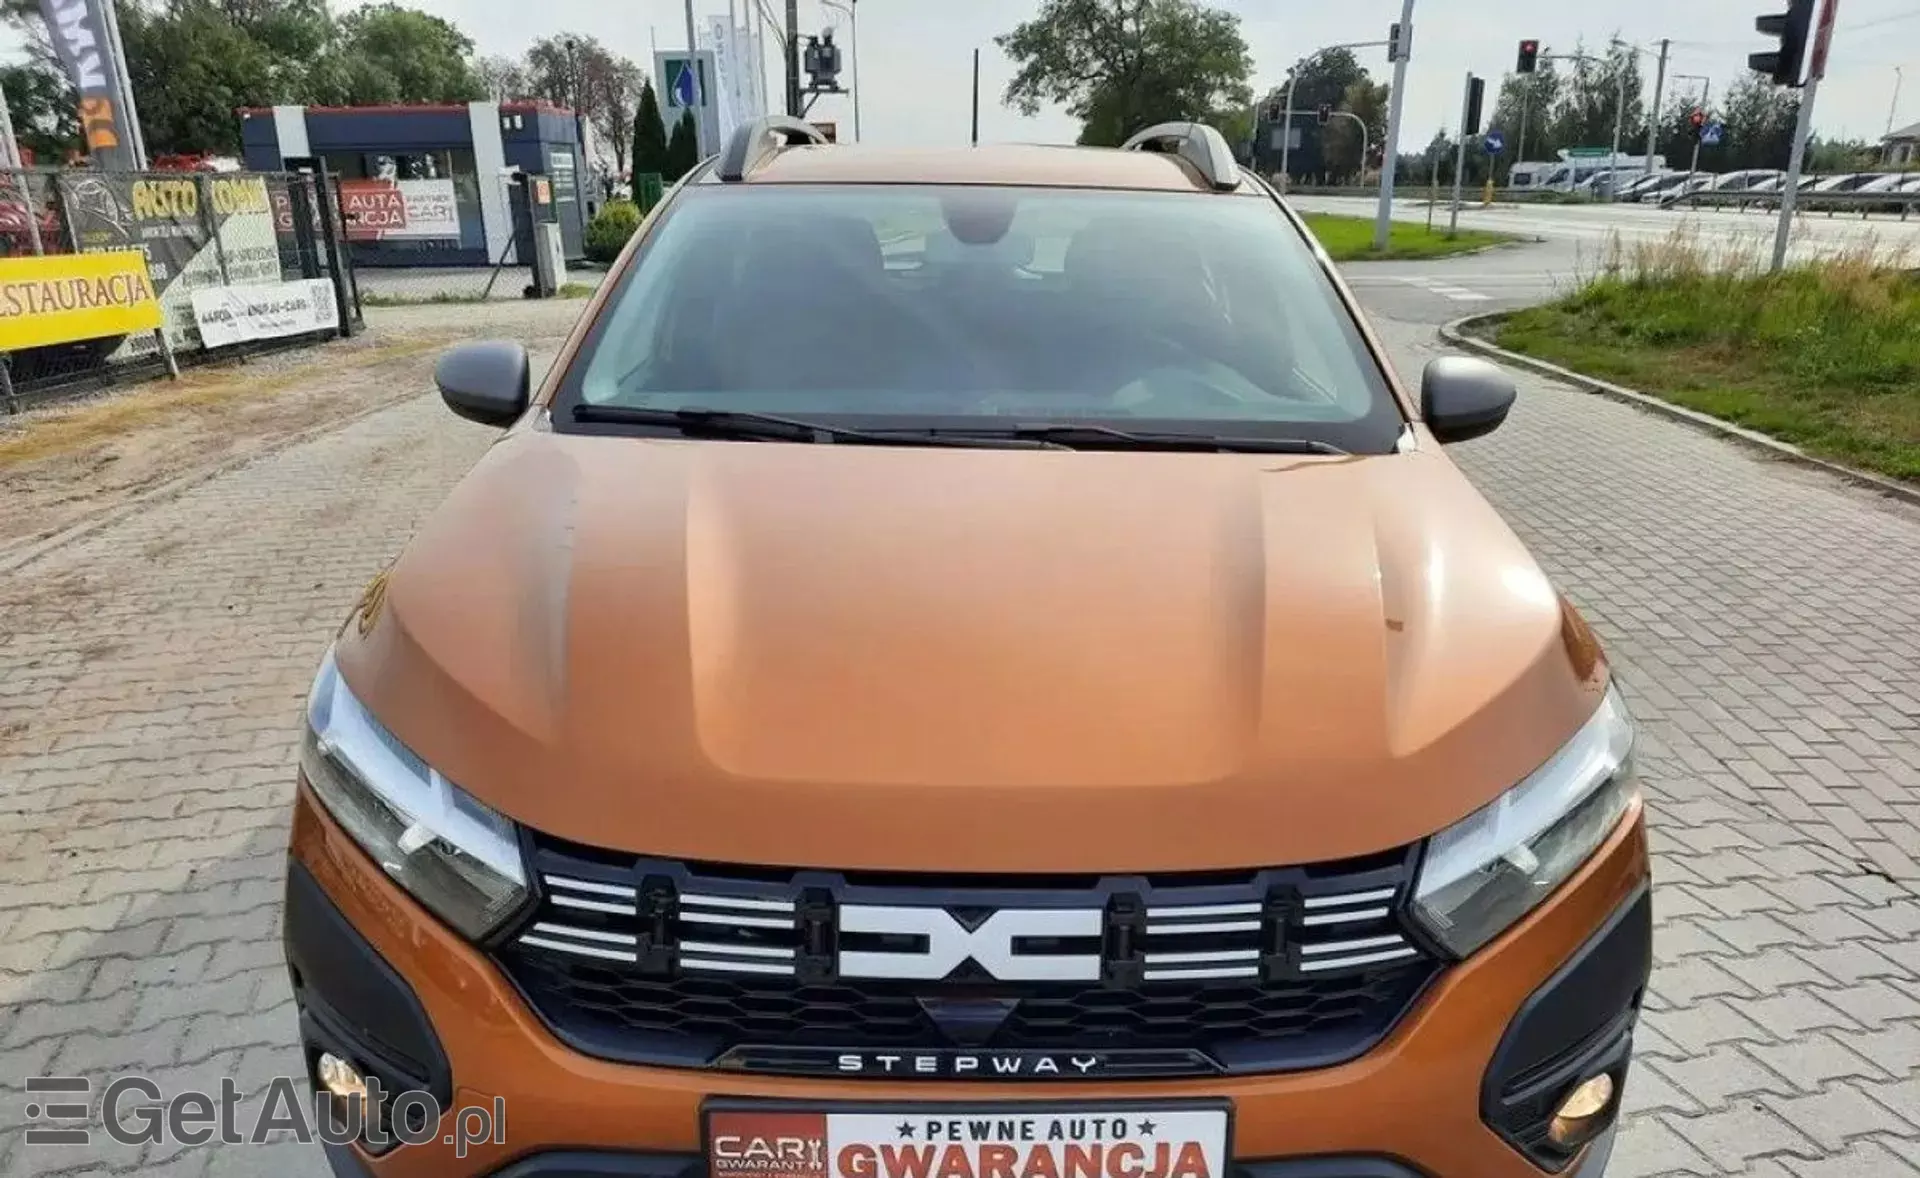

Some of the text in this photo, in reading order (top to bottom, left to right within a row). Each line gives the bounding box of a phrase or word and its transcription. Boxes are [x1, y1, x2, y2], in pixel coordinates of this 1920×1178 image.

[350, 194, 401, 209] AUTA
[0, 272, 150, 317] STAURACJA
[837, 1054, 1097, 1074] STEPWAY
[926, 1118, 1128, 1142] PEWNE AUTO
[714, 1136, 805, 1159] CAR
[715, 1160, 806, 1171] GWARANT
[836, 1141, 1211, 1178] GWARANCJA
